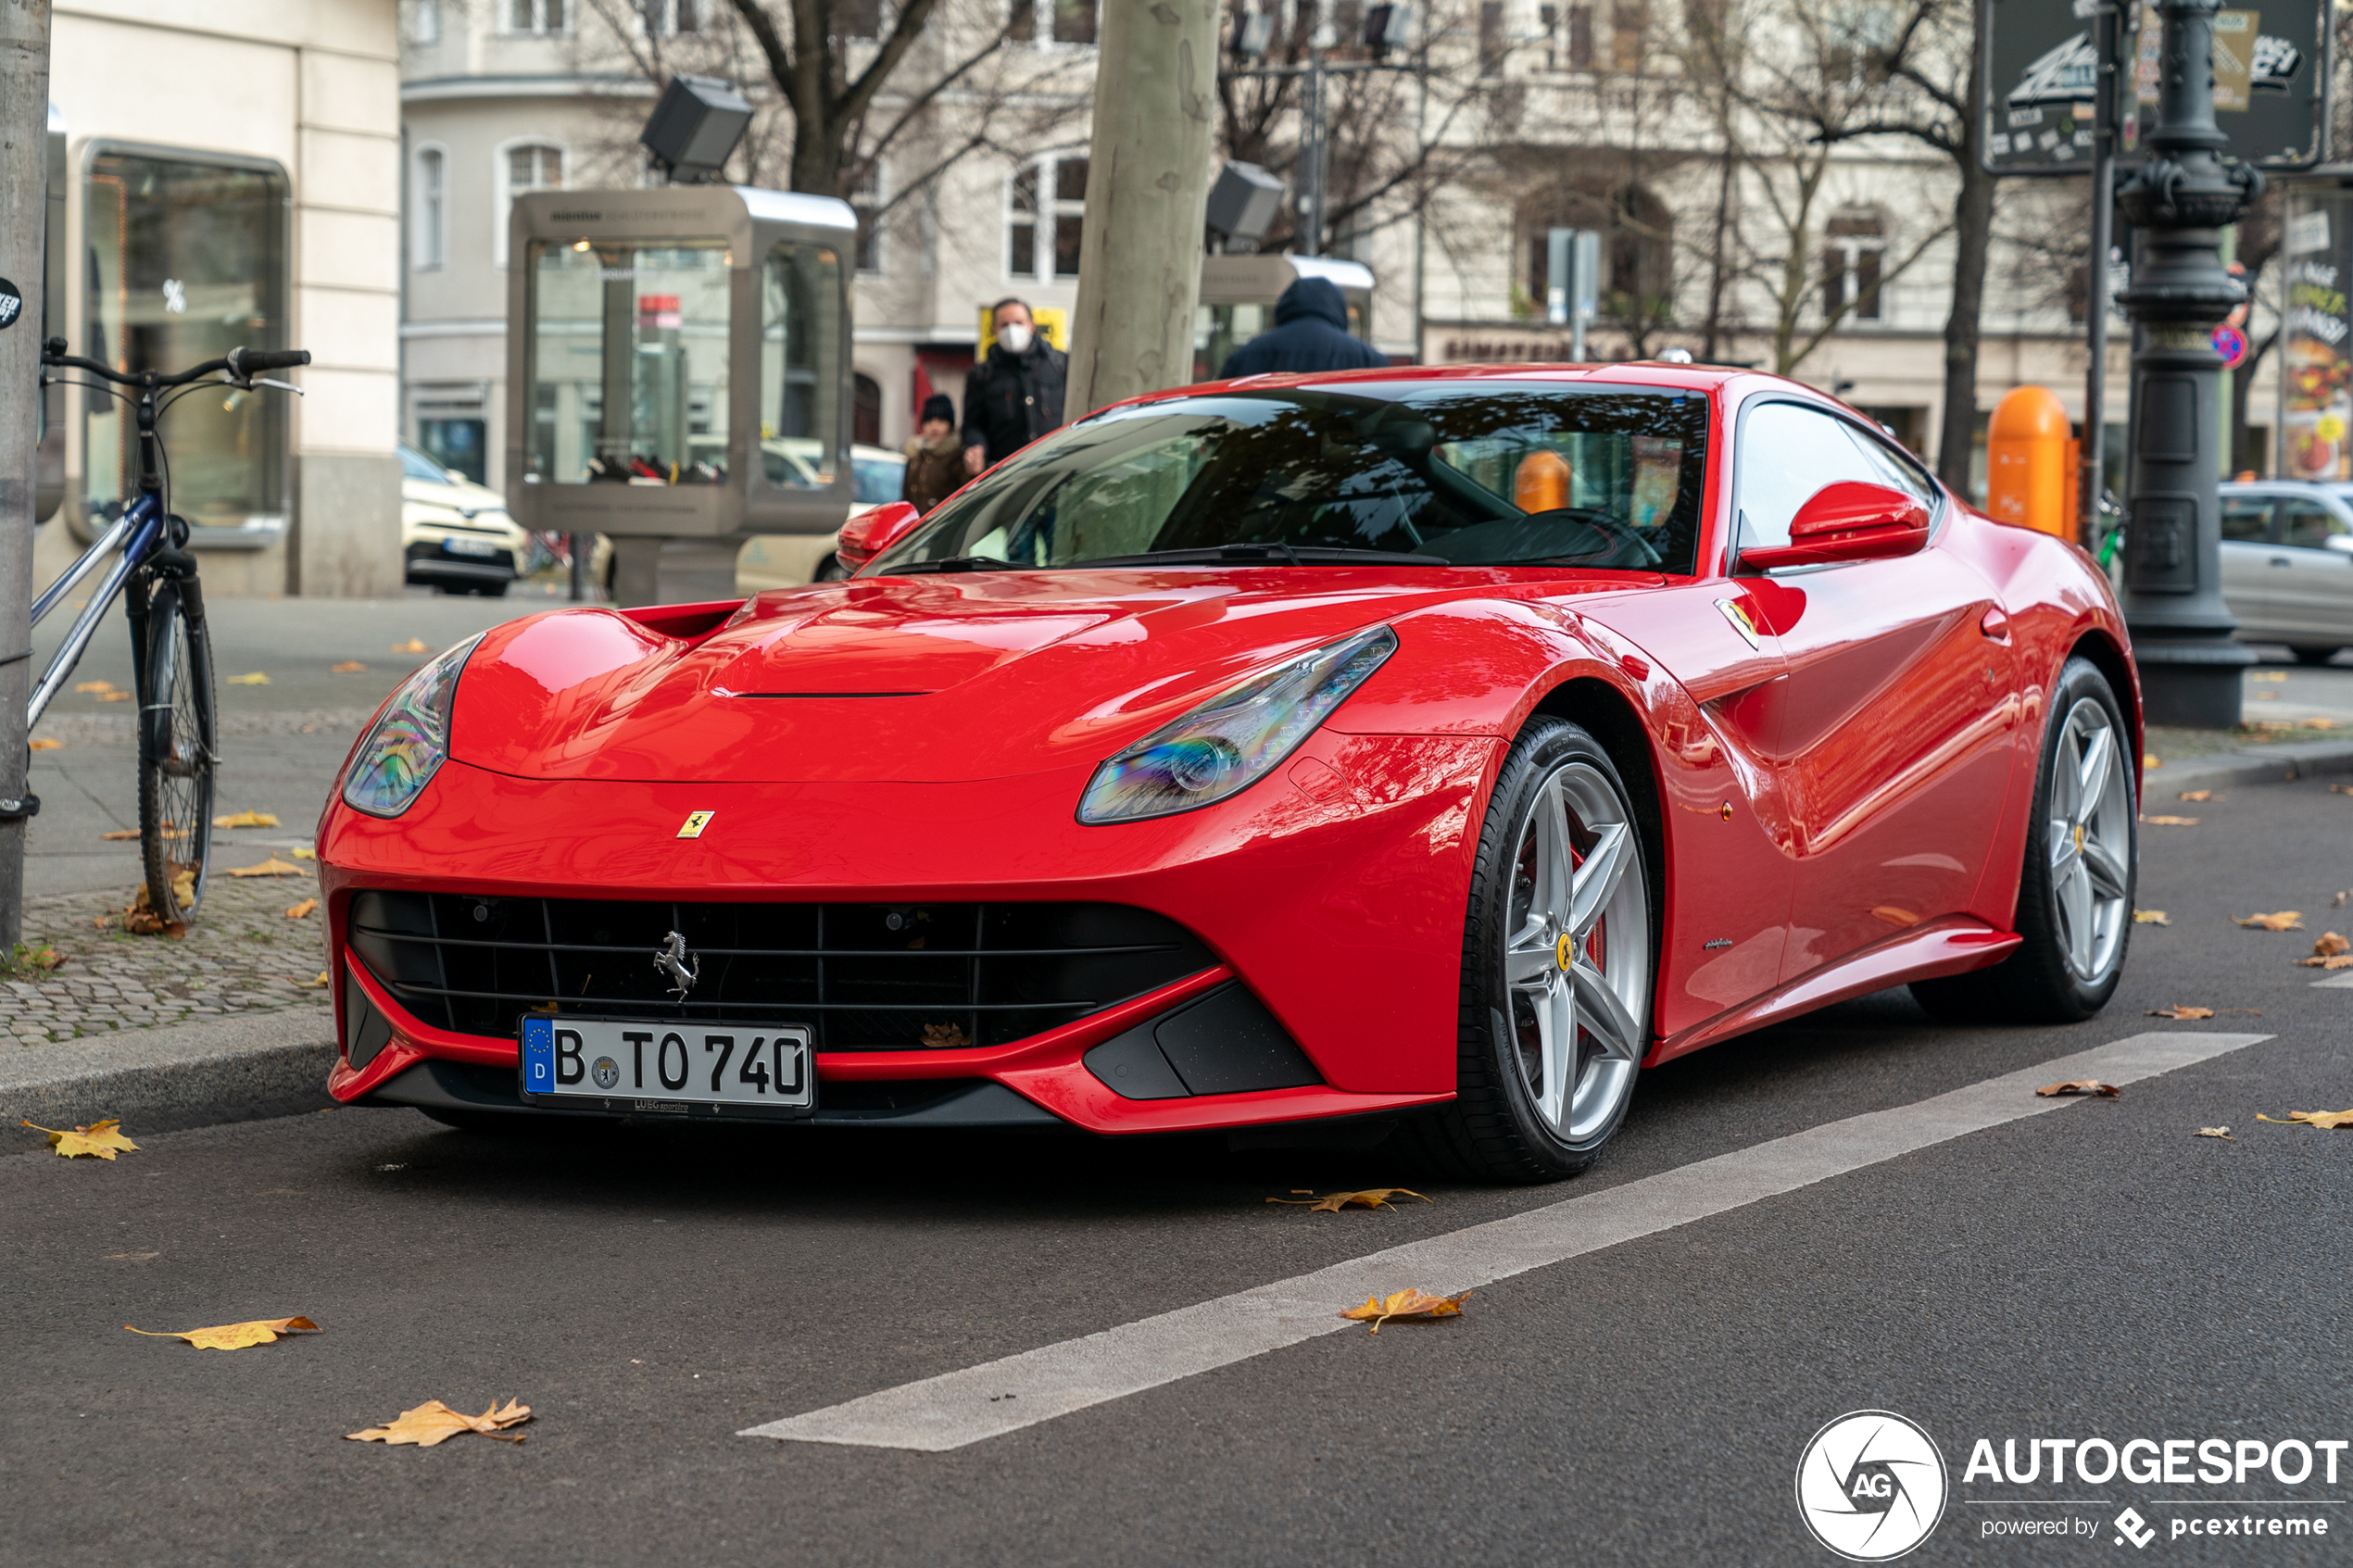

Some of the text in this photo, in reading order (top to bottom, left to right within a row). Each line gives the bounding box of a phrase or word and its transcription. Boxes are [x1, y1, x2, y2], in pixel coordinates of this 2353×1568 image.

[555, 1029, 585, 1085] B
[623, 1031, 689, 1091] TO
[705, 1035, 805, 1095] 740
[535, 1063, 546, 1079] D
[635, 1099, 689, 1111] LUEG sportivo
